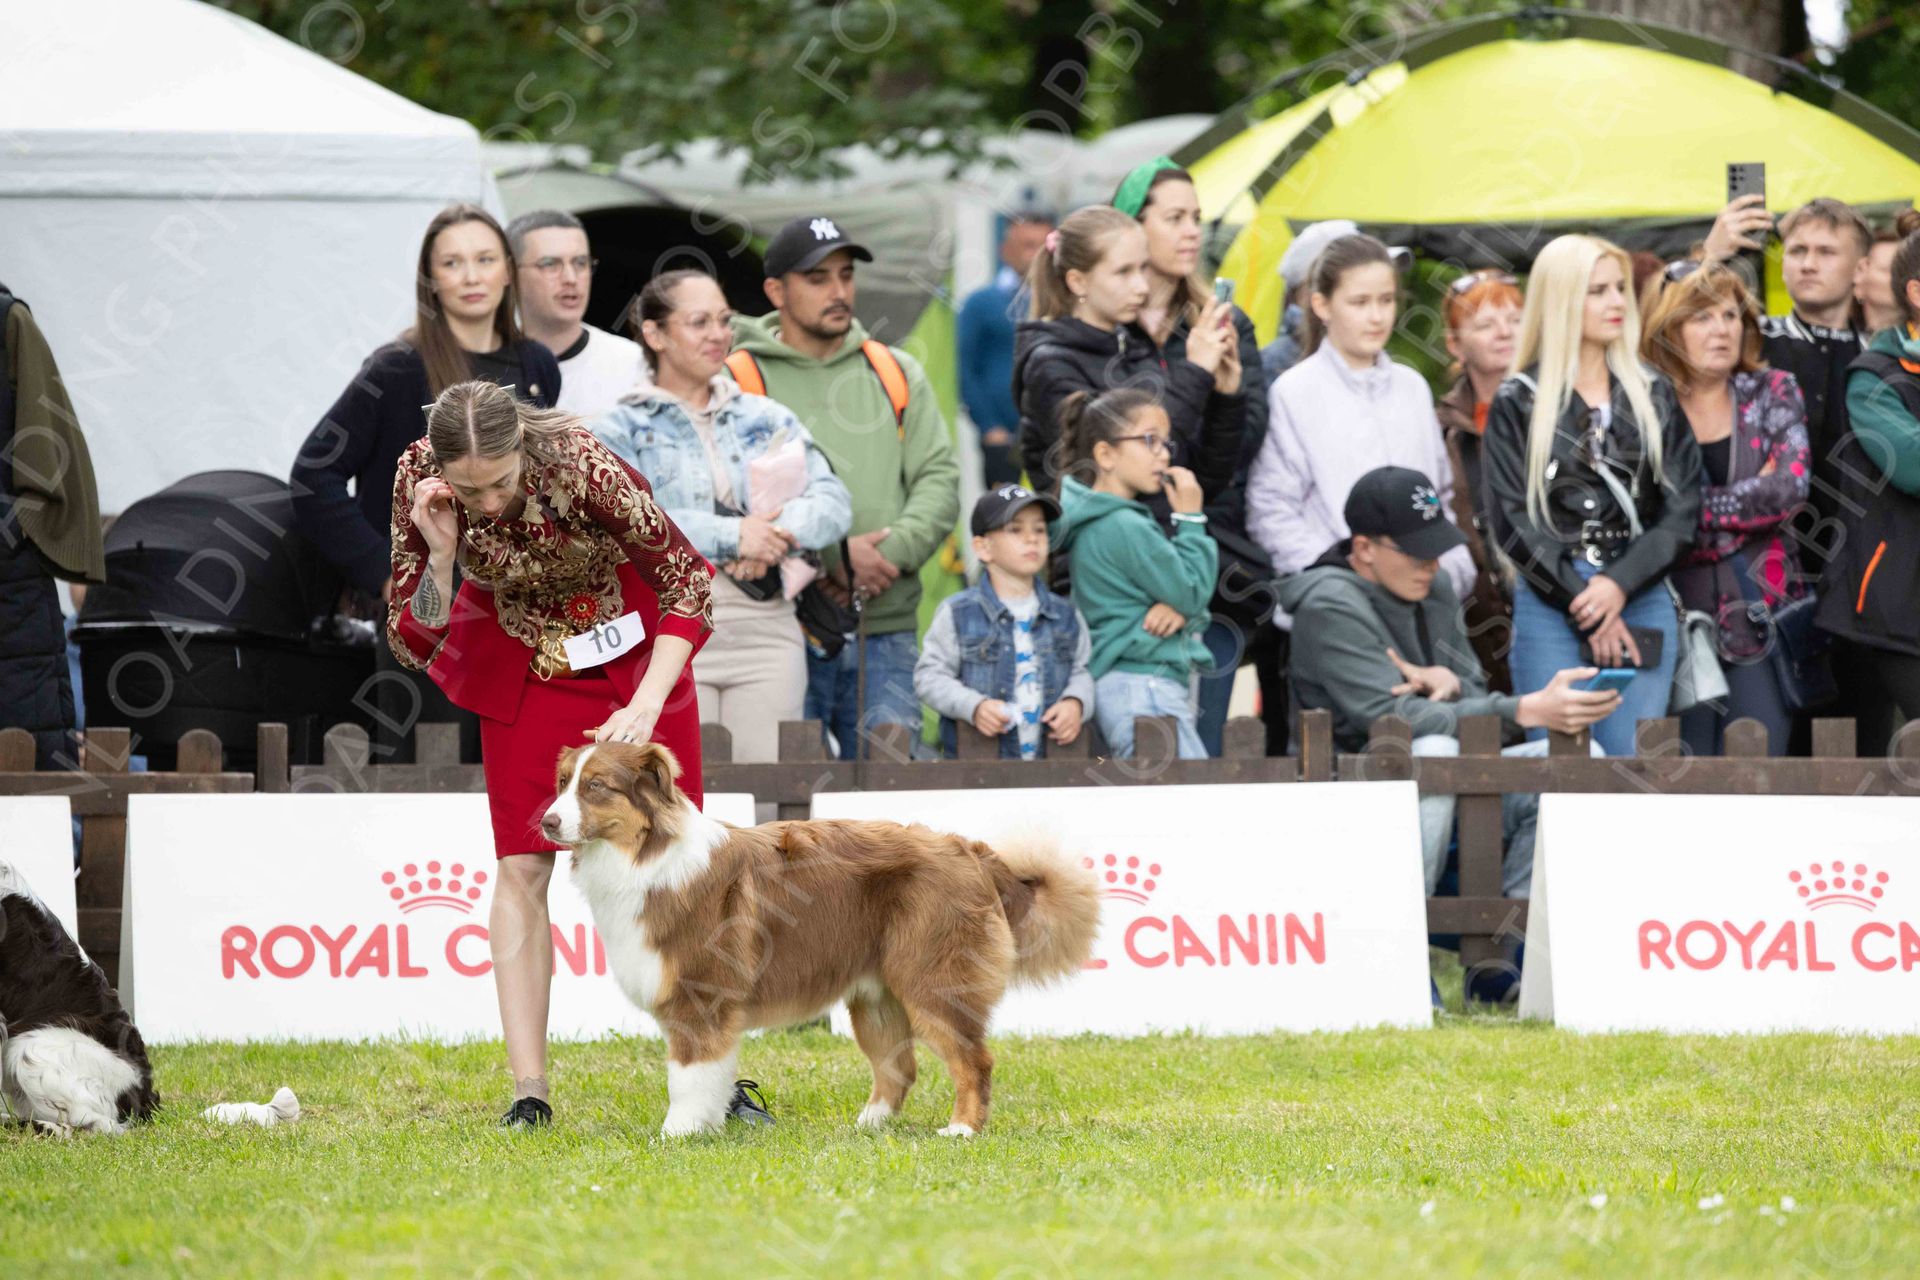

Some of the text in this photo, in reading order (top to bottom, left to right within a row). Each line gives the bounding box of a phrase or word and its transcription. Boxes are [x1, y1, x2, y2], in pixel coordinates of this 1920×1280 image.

[588, 624, 622, 654] 10
[221, 923, 429, 979] ROYAL
[1124, 912, 1326, 968] CANIN
[1638, 920, 1836, 972] ROYAL
